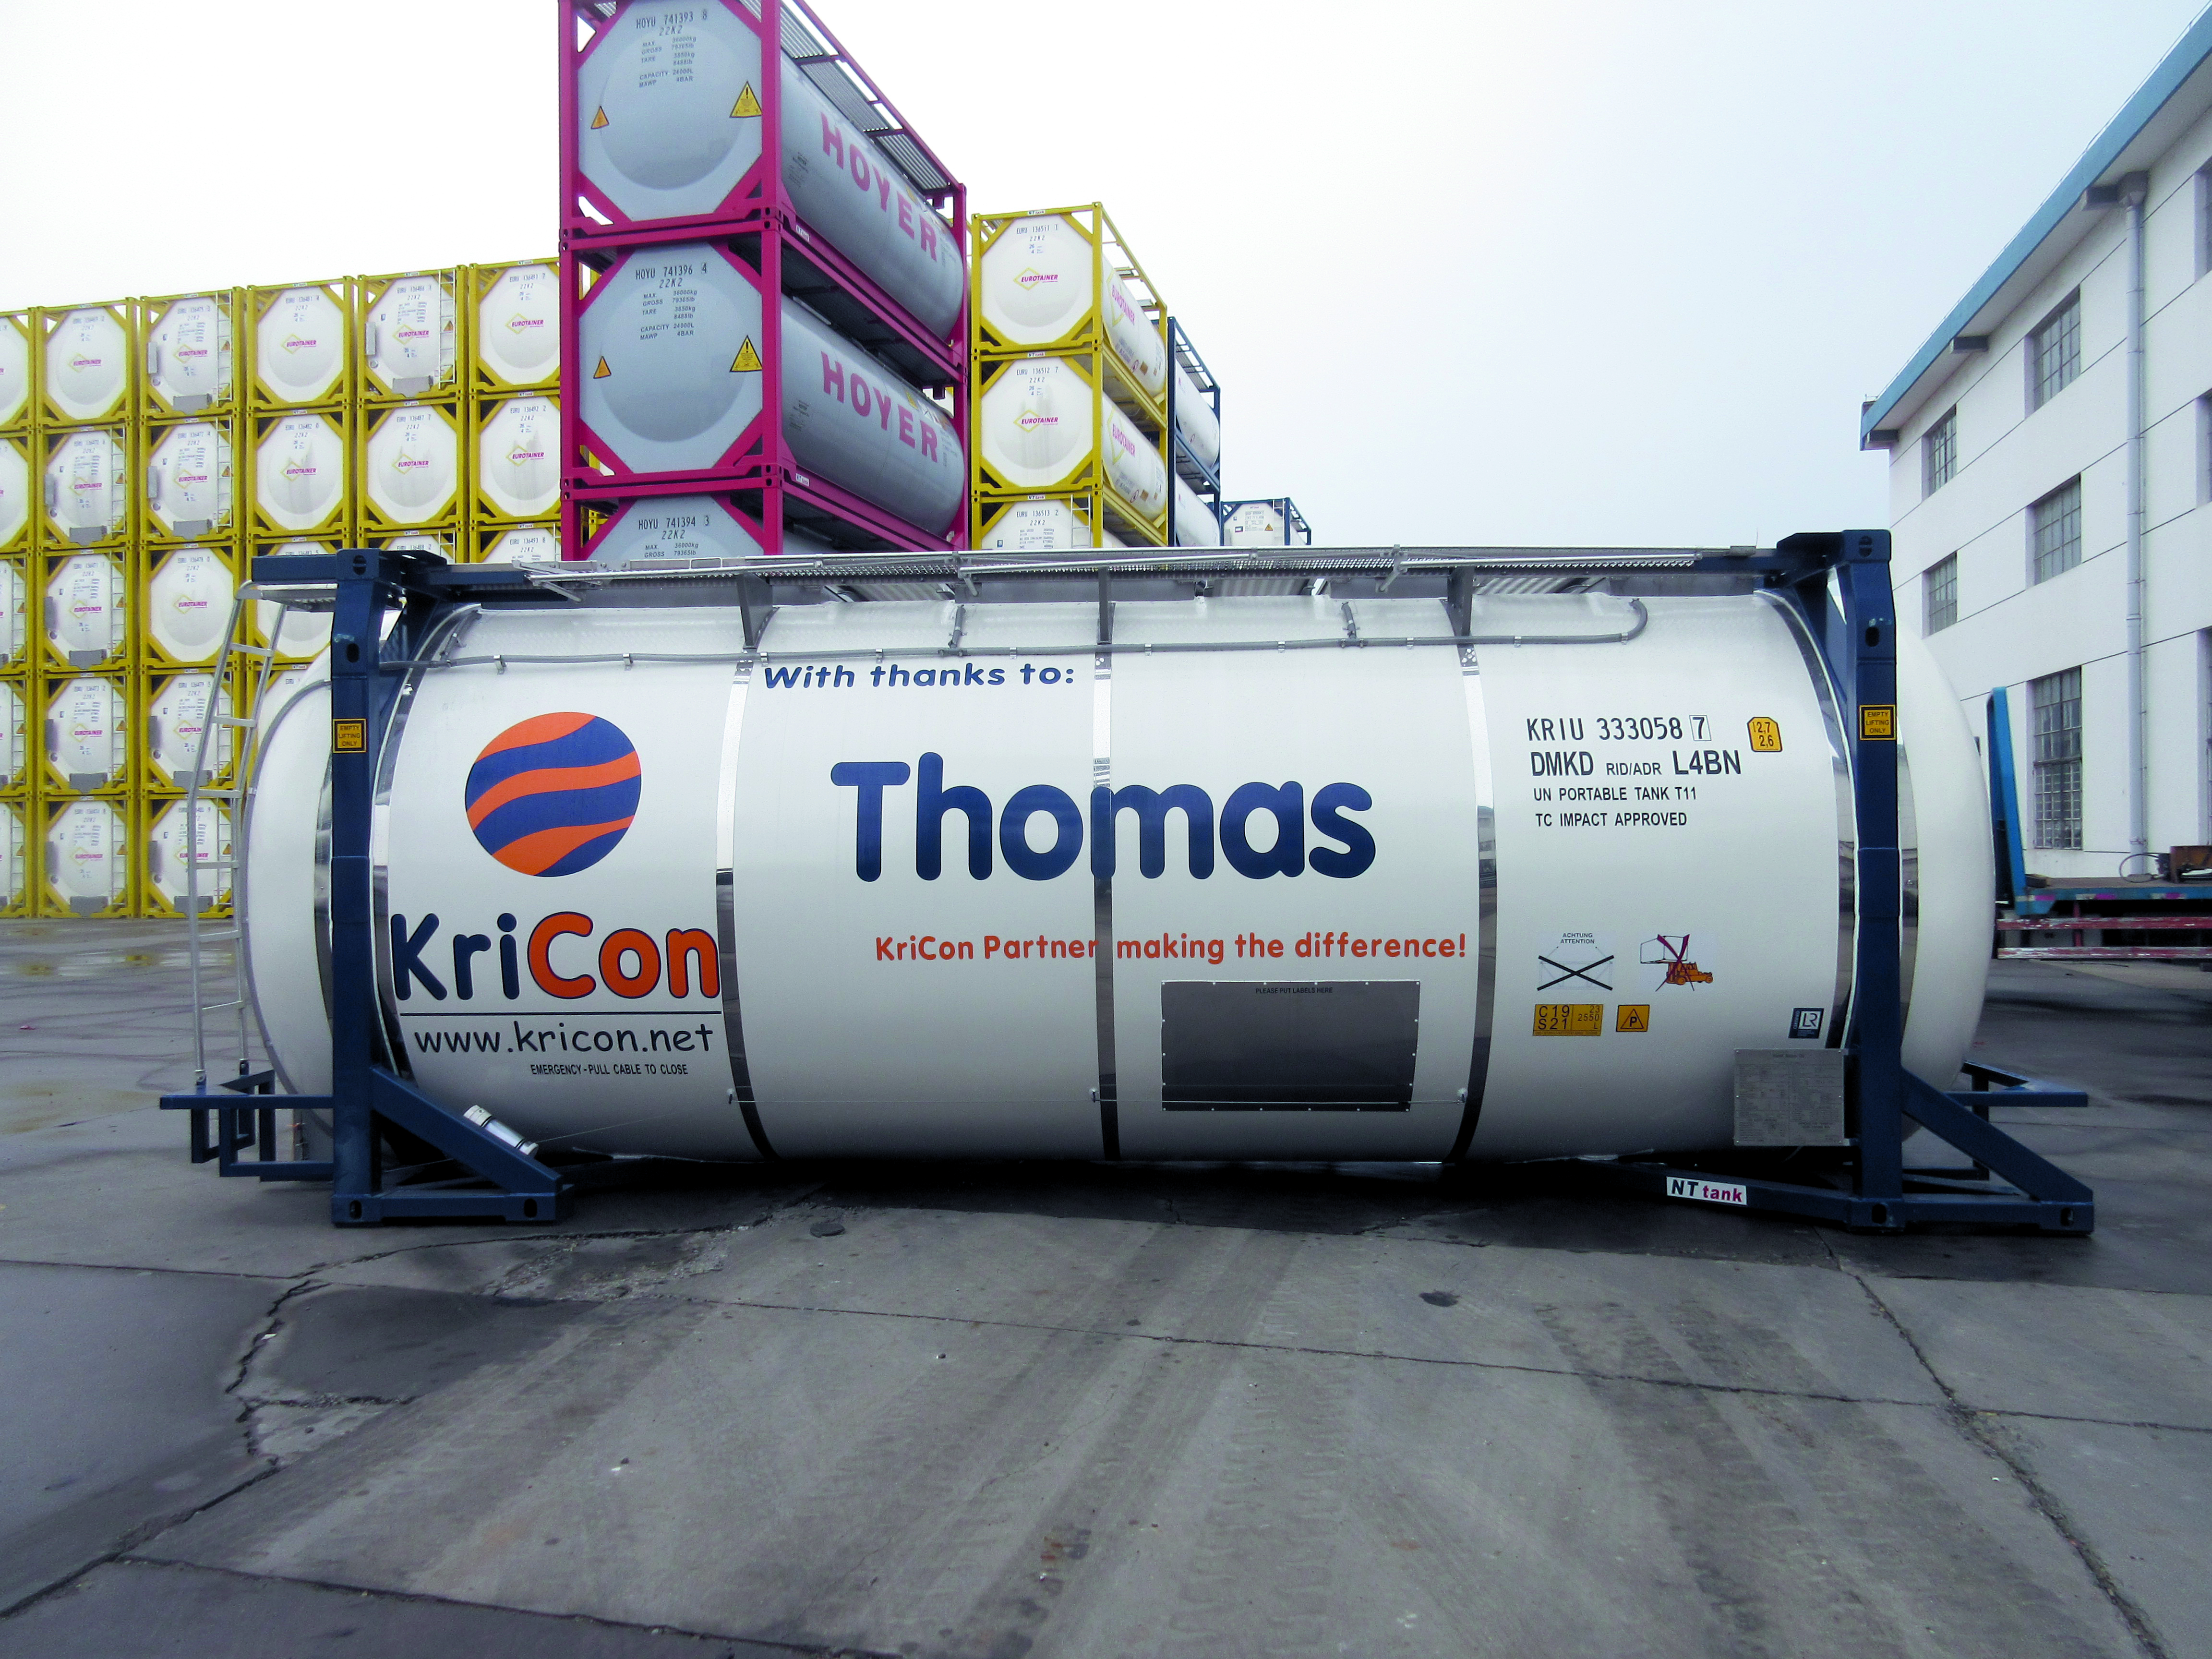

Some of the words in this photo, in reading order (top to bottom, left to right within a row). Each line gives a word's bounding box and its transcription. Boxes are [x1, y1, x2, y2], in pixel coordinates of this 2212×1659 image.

[636, 16, 655, 29] HOYU
[664, 12, 693, 24] 741393
[702, 9, 707, 20] 8
[659, 25, 683, 36] 22K2
[639, 72, 668, 80] CAPACITY
[820, 112, 937, 262] HOYER
[636, 268, 655, 279] HOYU
[663, 265, 693, 277] 741396
[702, 263, 707, 273] 4
[659, 278, 683, 288] 22K2
[821, 351, 938, 462] HOYER
[638, 519, 658, 529] HOYU
[666, 516, 695, 528] 741394
[705, 515, 709, 526] 3
[662, 529, 685, 540] 22K2
[765, 665, 855, 688] With
[870, 663, 1005, 687] thanks
[1020, 663, 1074, 684] to:
[1527, 718, 1584, 741] KRIU
[1597, 717, 1683, 740] 333058
[1692, 717, 1705, 739] 7
[1759, 735, 1774, 747] 2,6
[1530, 751, 1593, 776] DMKD
[1607, 763, 1662, 775] RID/ADR
[1672, 750, 1741, 774] L4BN
[1534, 788, 1551, 801] UN
[1560, 787, 1627, 801] PORTABLE
[1635, 787, 1669, 800] TANK
[1675, 787, 1697, 800] T11
[830, 752, 1376, 881] Thomas
[1536, 813, 1552, 827] TC
[1560, 813, 1607, 827] IMPACT
[1615, 812, 1686, 826] APPROVED
[391, 911, 721, 1001] KriCon
[876, 935, 974, 961] KriCon
[984, 935, 1097, 959] Partner
[1117, 933, 1224, 964] making
[1235, 933, 1284, 957] the
[1295, 932, 1466, 957] difference!
[1629, 1017, 1637, 1027] P
[1803, 1013, 1817, 1027] LR
[415, 1021, 713, 1053] www.kricon.net
[613, 1064, 641, 1074] CABLE
[645, 1064, 656, 1074] TO
[661, 1064, 688, 1074] CLOSE
[1671, 1179, 1699, 1196] NT
[1703, 1186, 1742, 1202] tank
